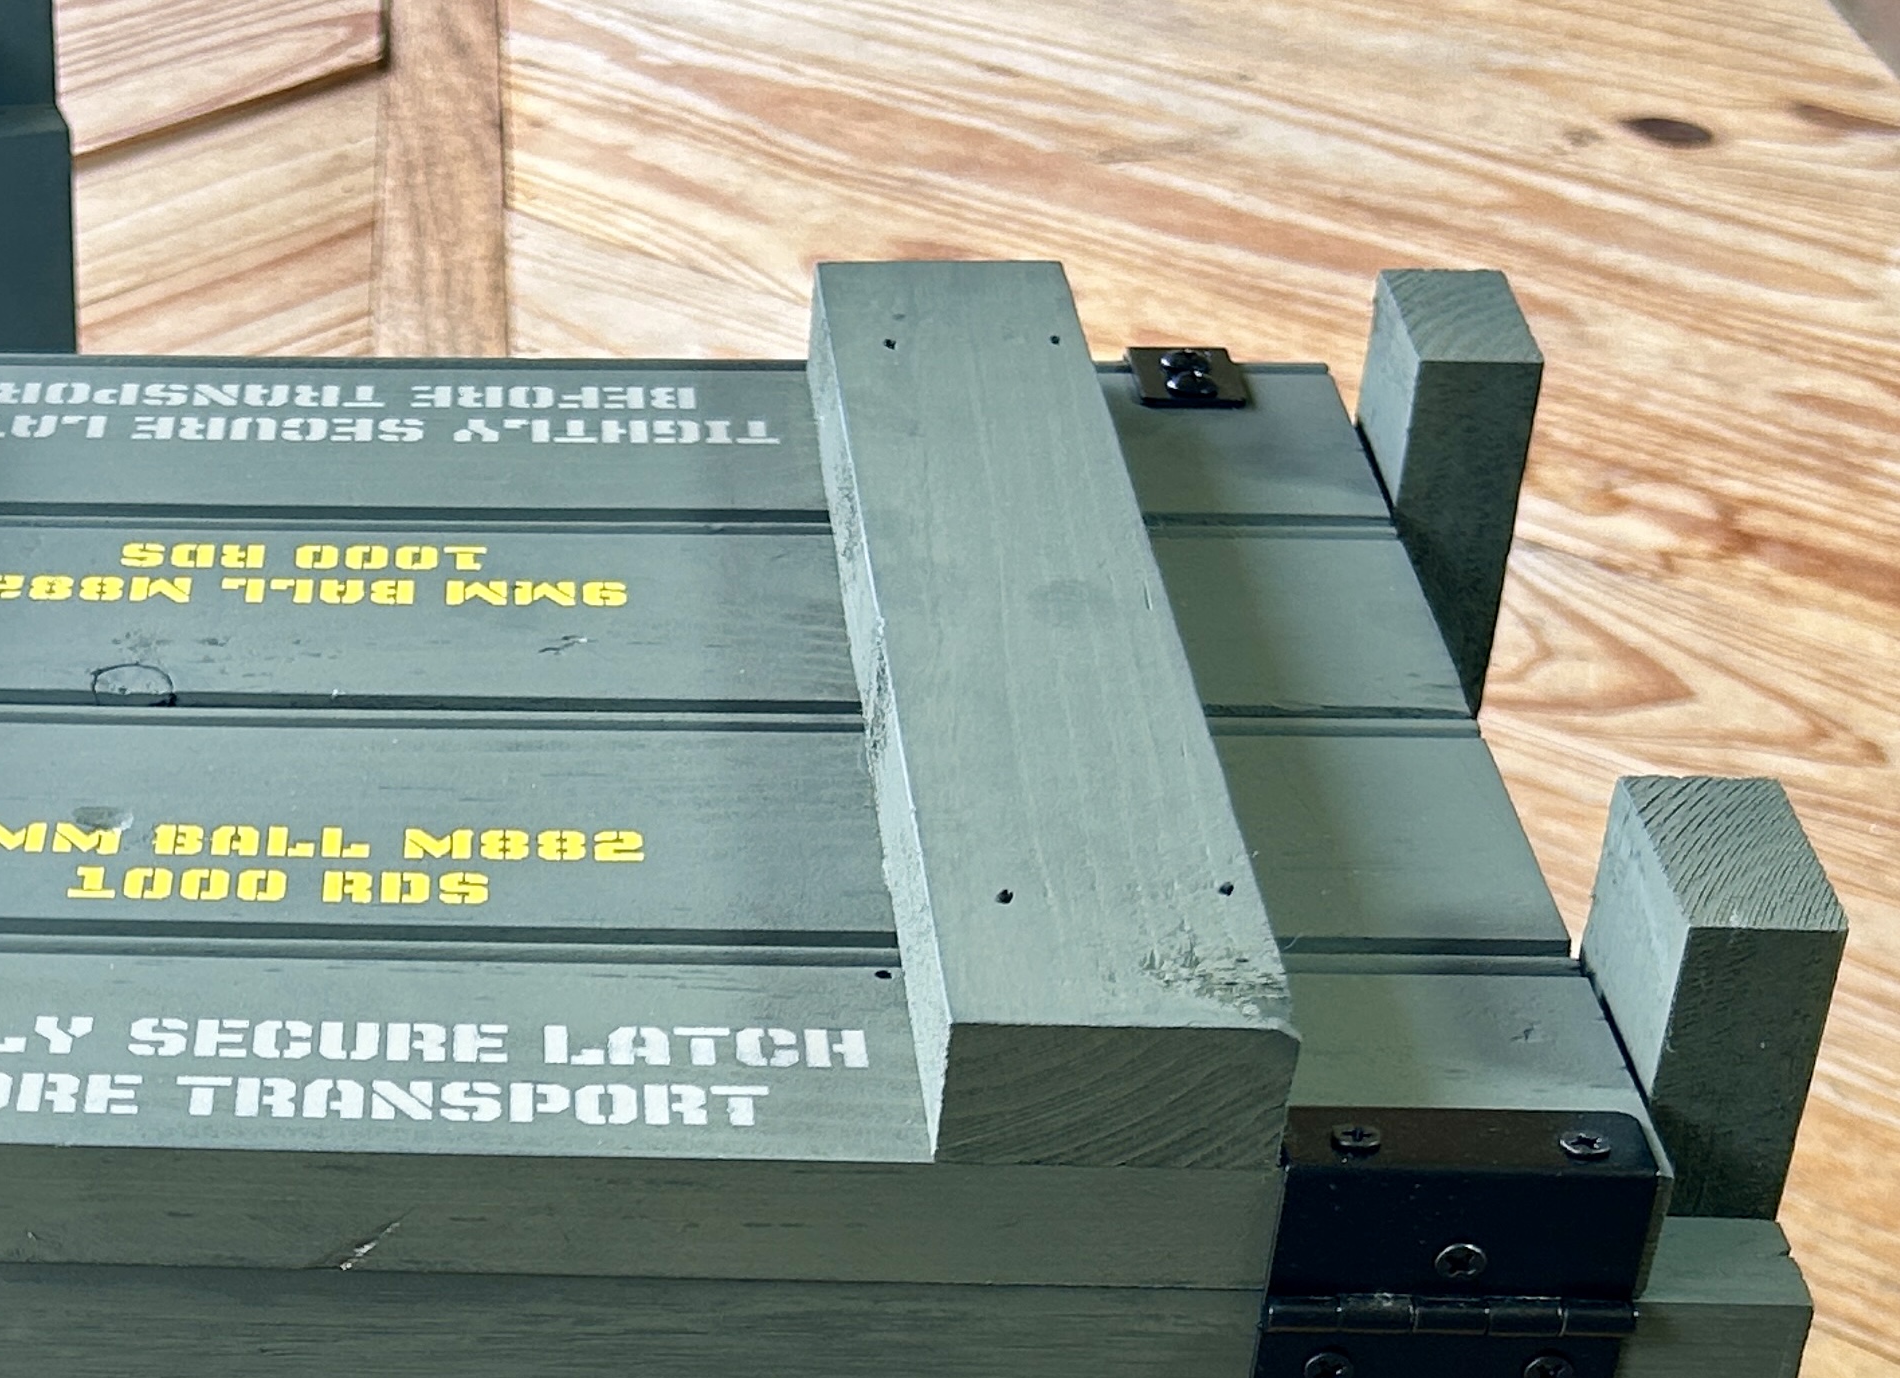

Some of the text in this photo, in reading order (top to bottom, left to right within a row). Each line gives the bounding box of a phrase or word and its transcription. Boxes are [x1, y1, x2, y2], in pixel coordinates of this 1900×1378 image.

[408, 385, 698, 411] BEFORE
[130, 412, 427, 443] SECURE
[451, 416, 783, 446] TIGHTLY
[120, 541, 489, 571] 1000 RDS
[218, 575, 415, 605] BALL
[444, 578, 628, 607] 9MM
[152, 823, 372, 860] BALL
[403, 826, 645, 863] M882
[66, 864, 489, 906] 1000 RDS
[126, 1016, 510, 1064] SECURE
[542, 1023, 871, 1070] LATCH
[175, 1073, 772, 1128] TRANSPORT
